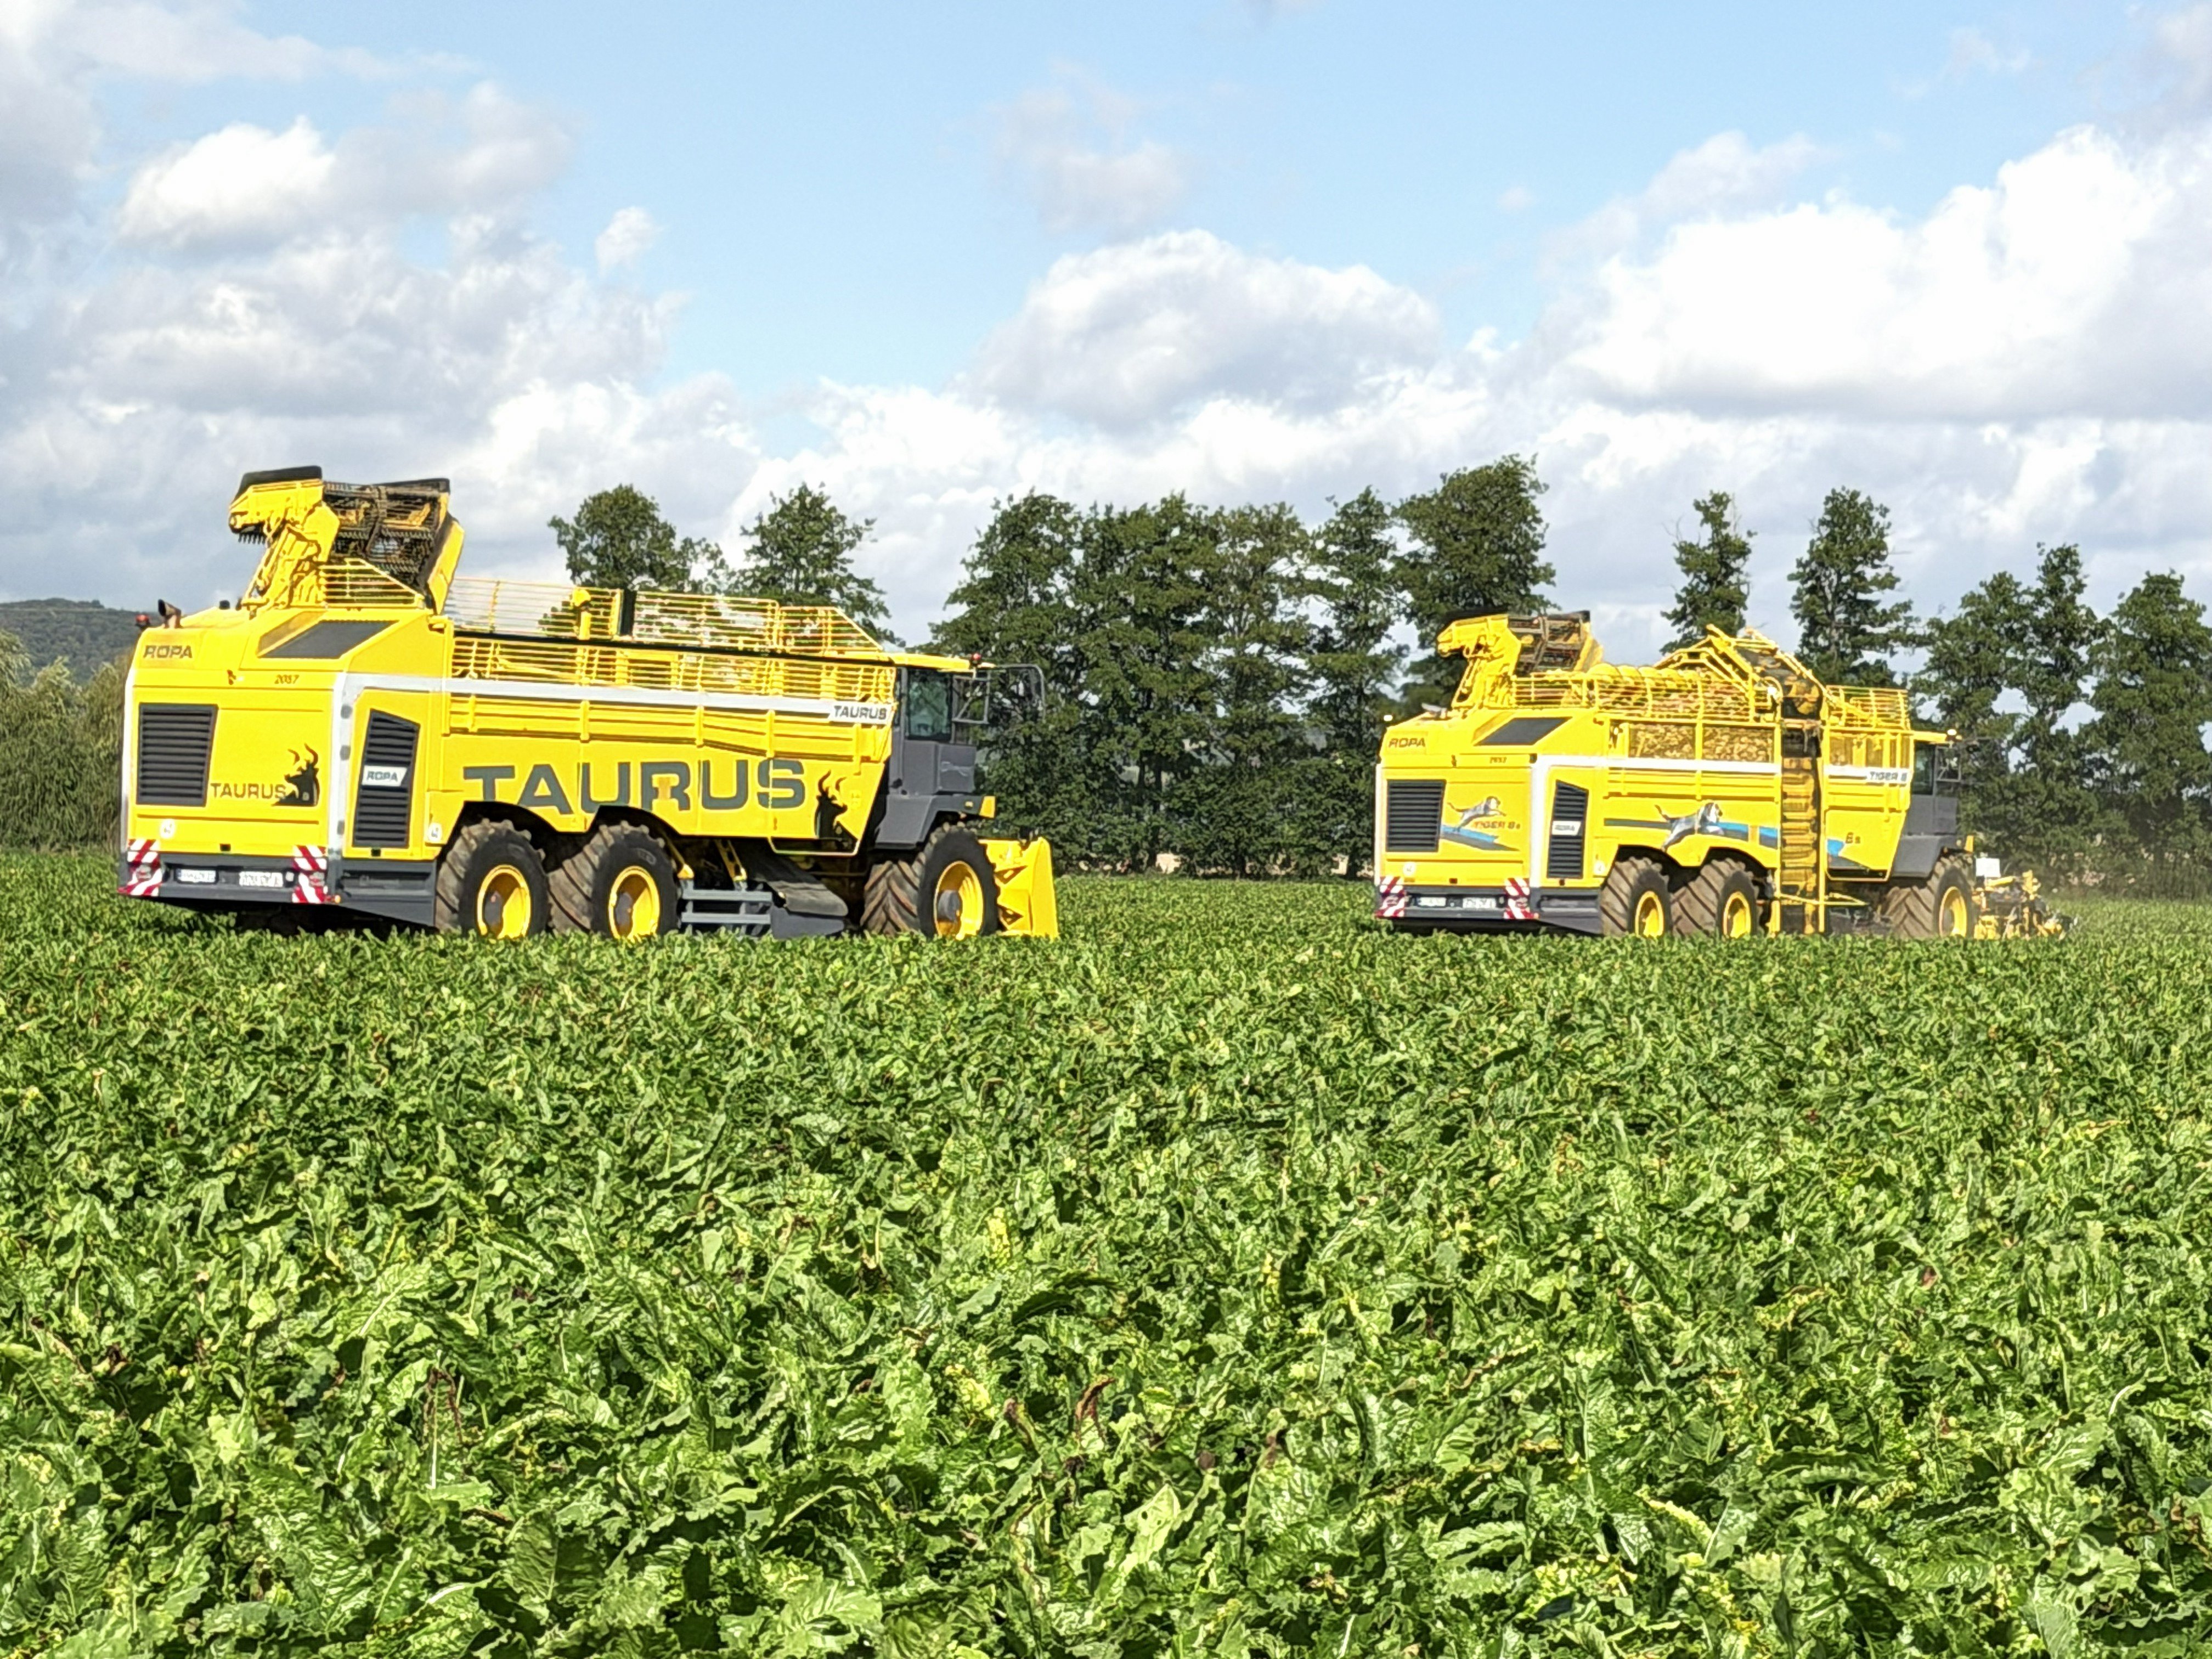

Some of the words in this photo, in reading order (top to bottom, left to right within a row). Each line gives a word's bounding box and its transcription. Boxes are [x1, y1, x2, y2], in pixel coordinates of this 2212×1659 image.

[143, 645, 193, 658] ROPA
[833, 705, 887, 720] TAURUS
[1388, 737, 1426, 748] ROPA
[366, 771, 398, 782] ROPA
[210, 783, 286, 799] TAURUS
[464, 759, 806, 815] TAURUS
